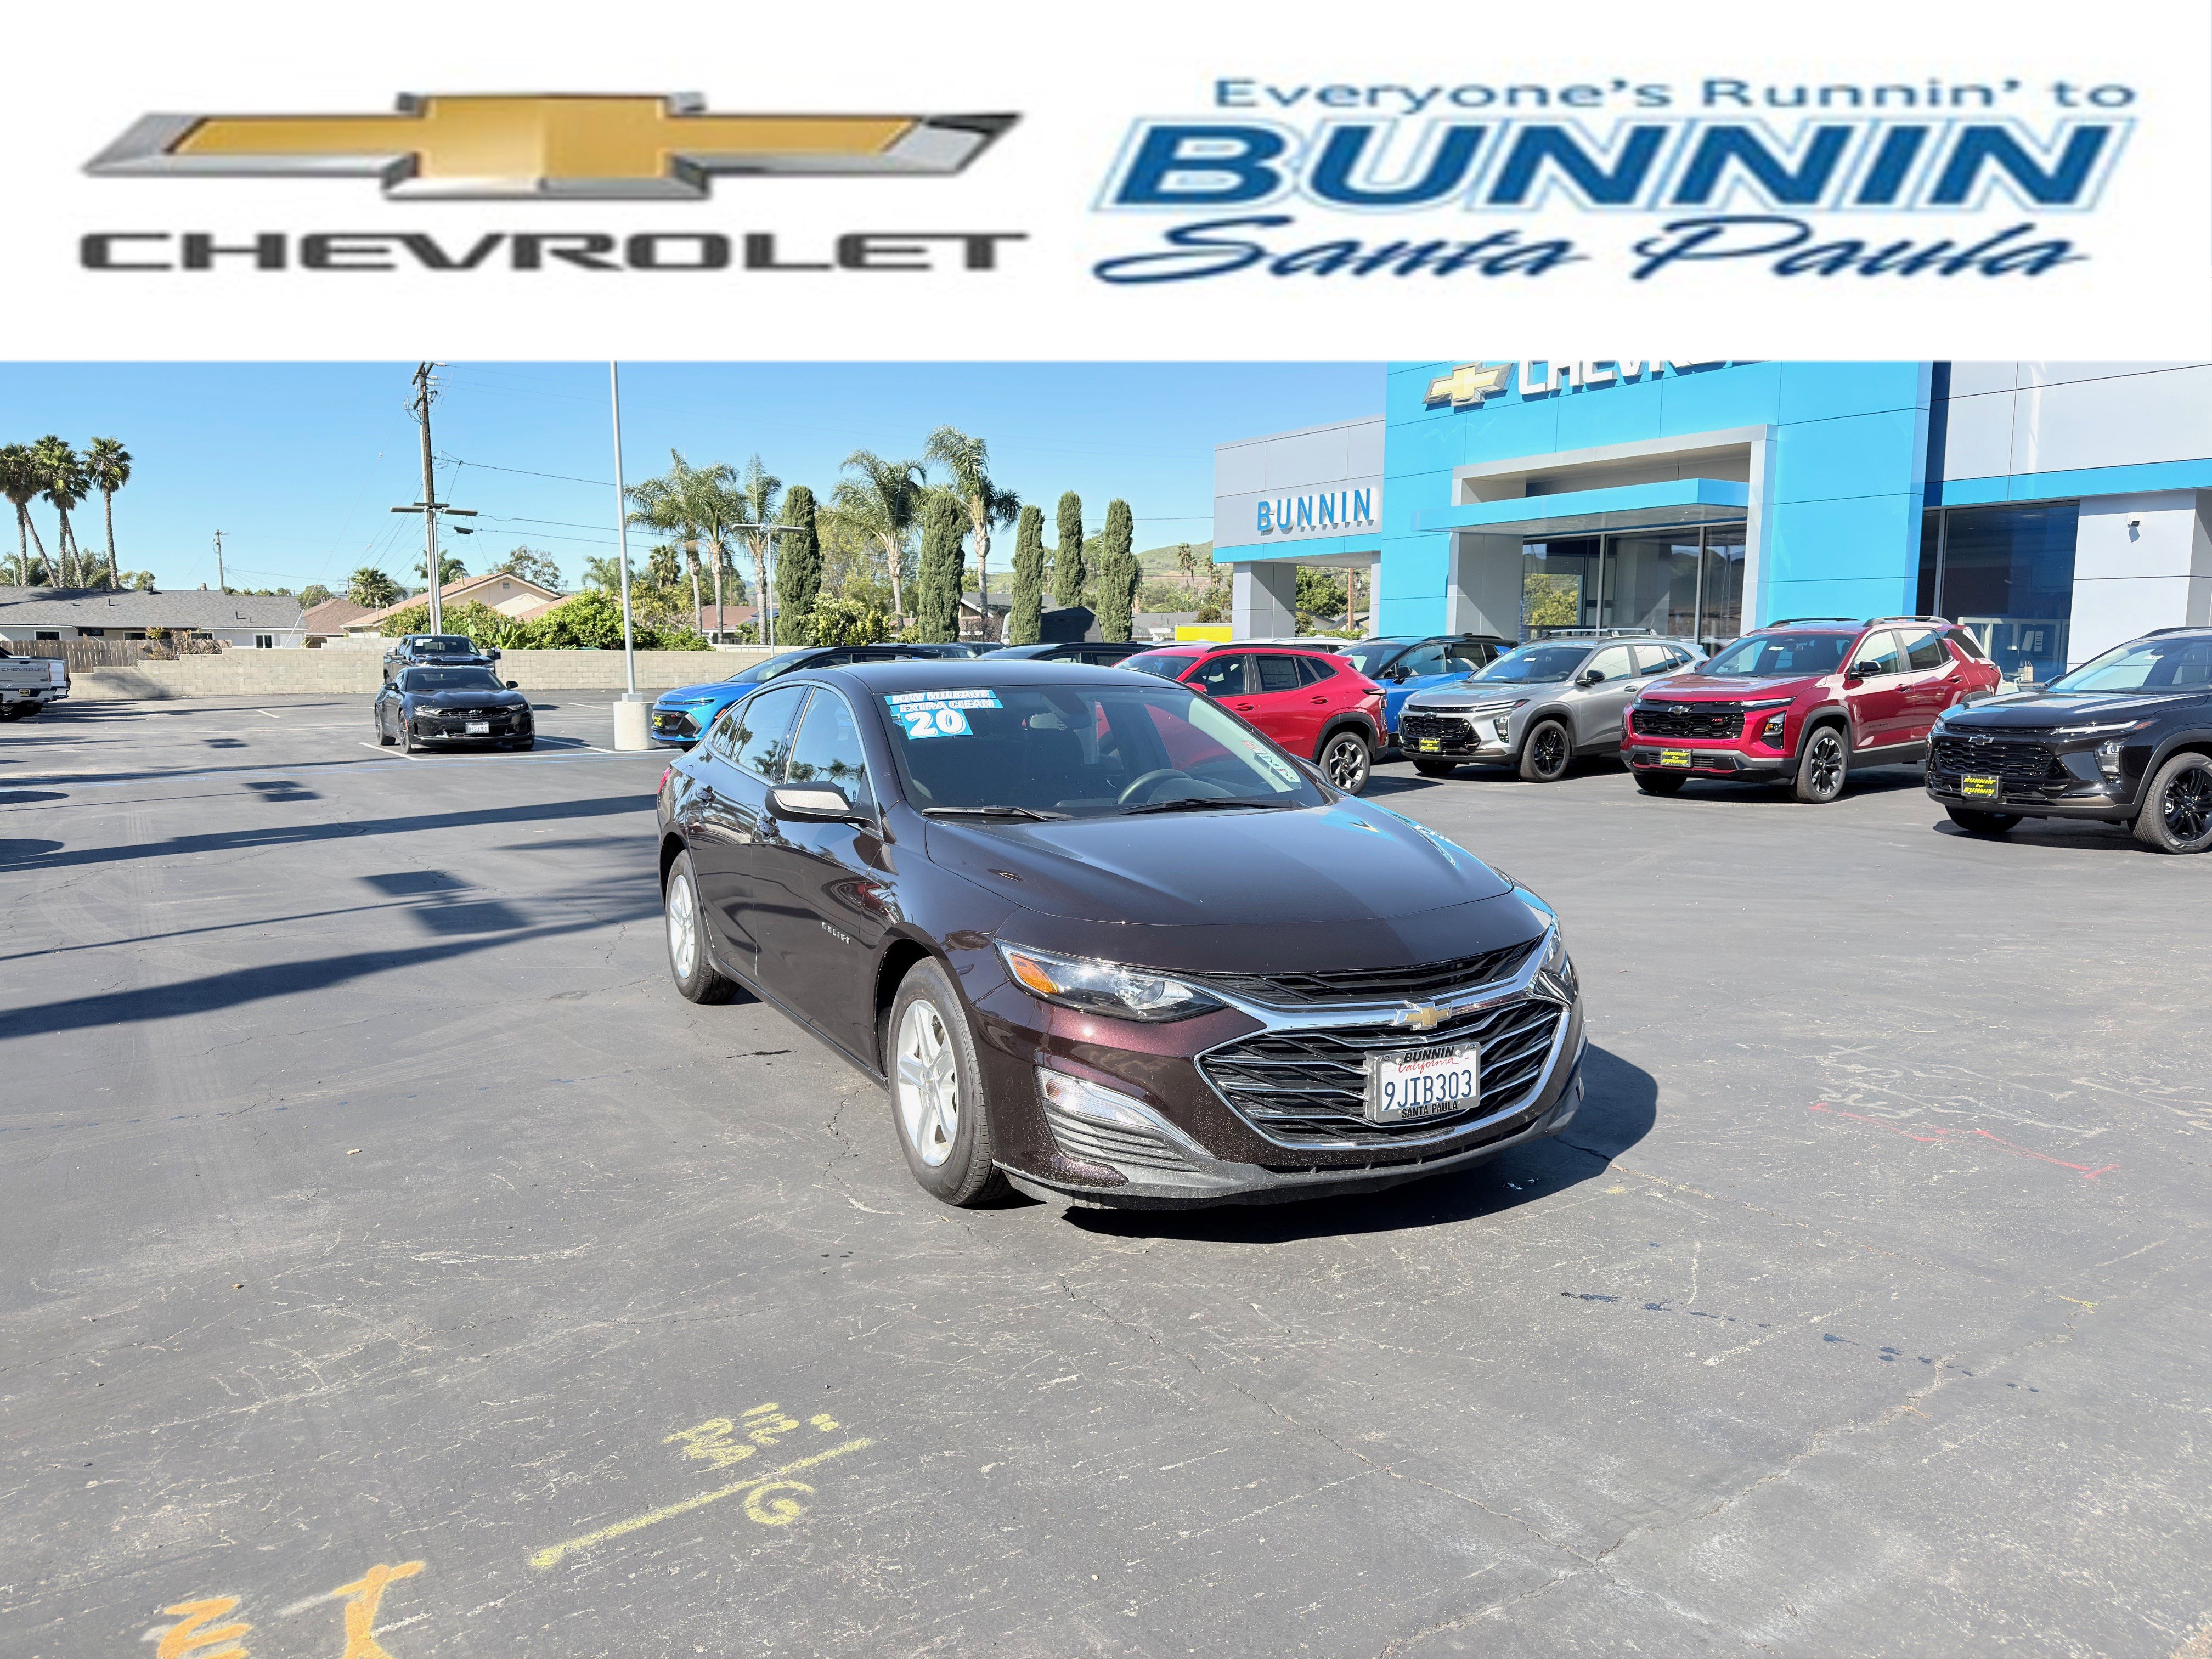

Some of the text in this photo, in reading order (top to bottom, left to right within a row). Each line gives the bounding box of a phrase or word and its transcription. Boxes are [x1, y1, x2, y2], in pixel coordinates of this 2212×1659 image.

[1257, 488, 1373, 531] BUNNIN
[892, 690, 990, 702] LOW MILEAGE
[900, 699, 995, 713] EXTRA CLEAN
[905, 709, 966, 737] 20
[1404, 1047, 1454, 1063] BUNNIN
[1398, 1057, 1460, 1075] California
[1384, 1069, 1472, 1111] 9JIB303
[1402, 1101, 1458, 1119] SANTA PAULA
